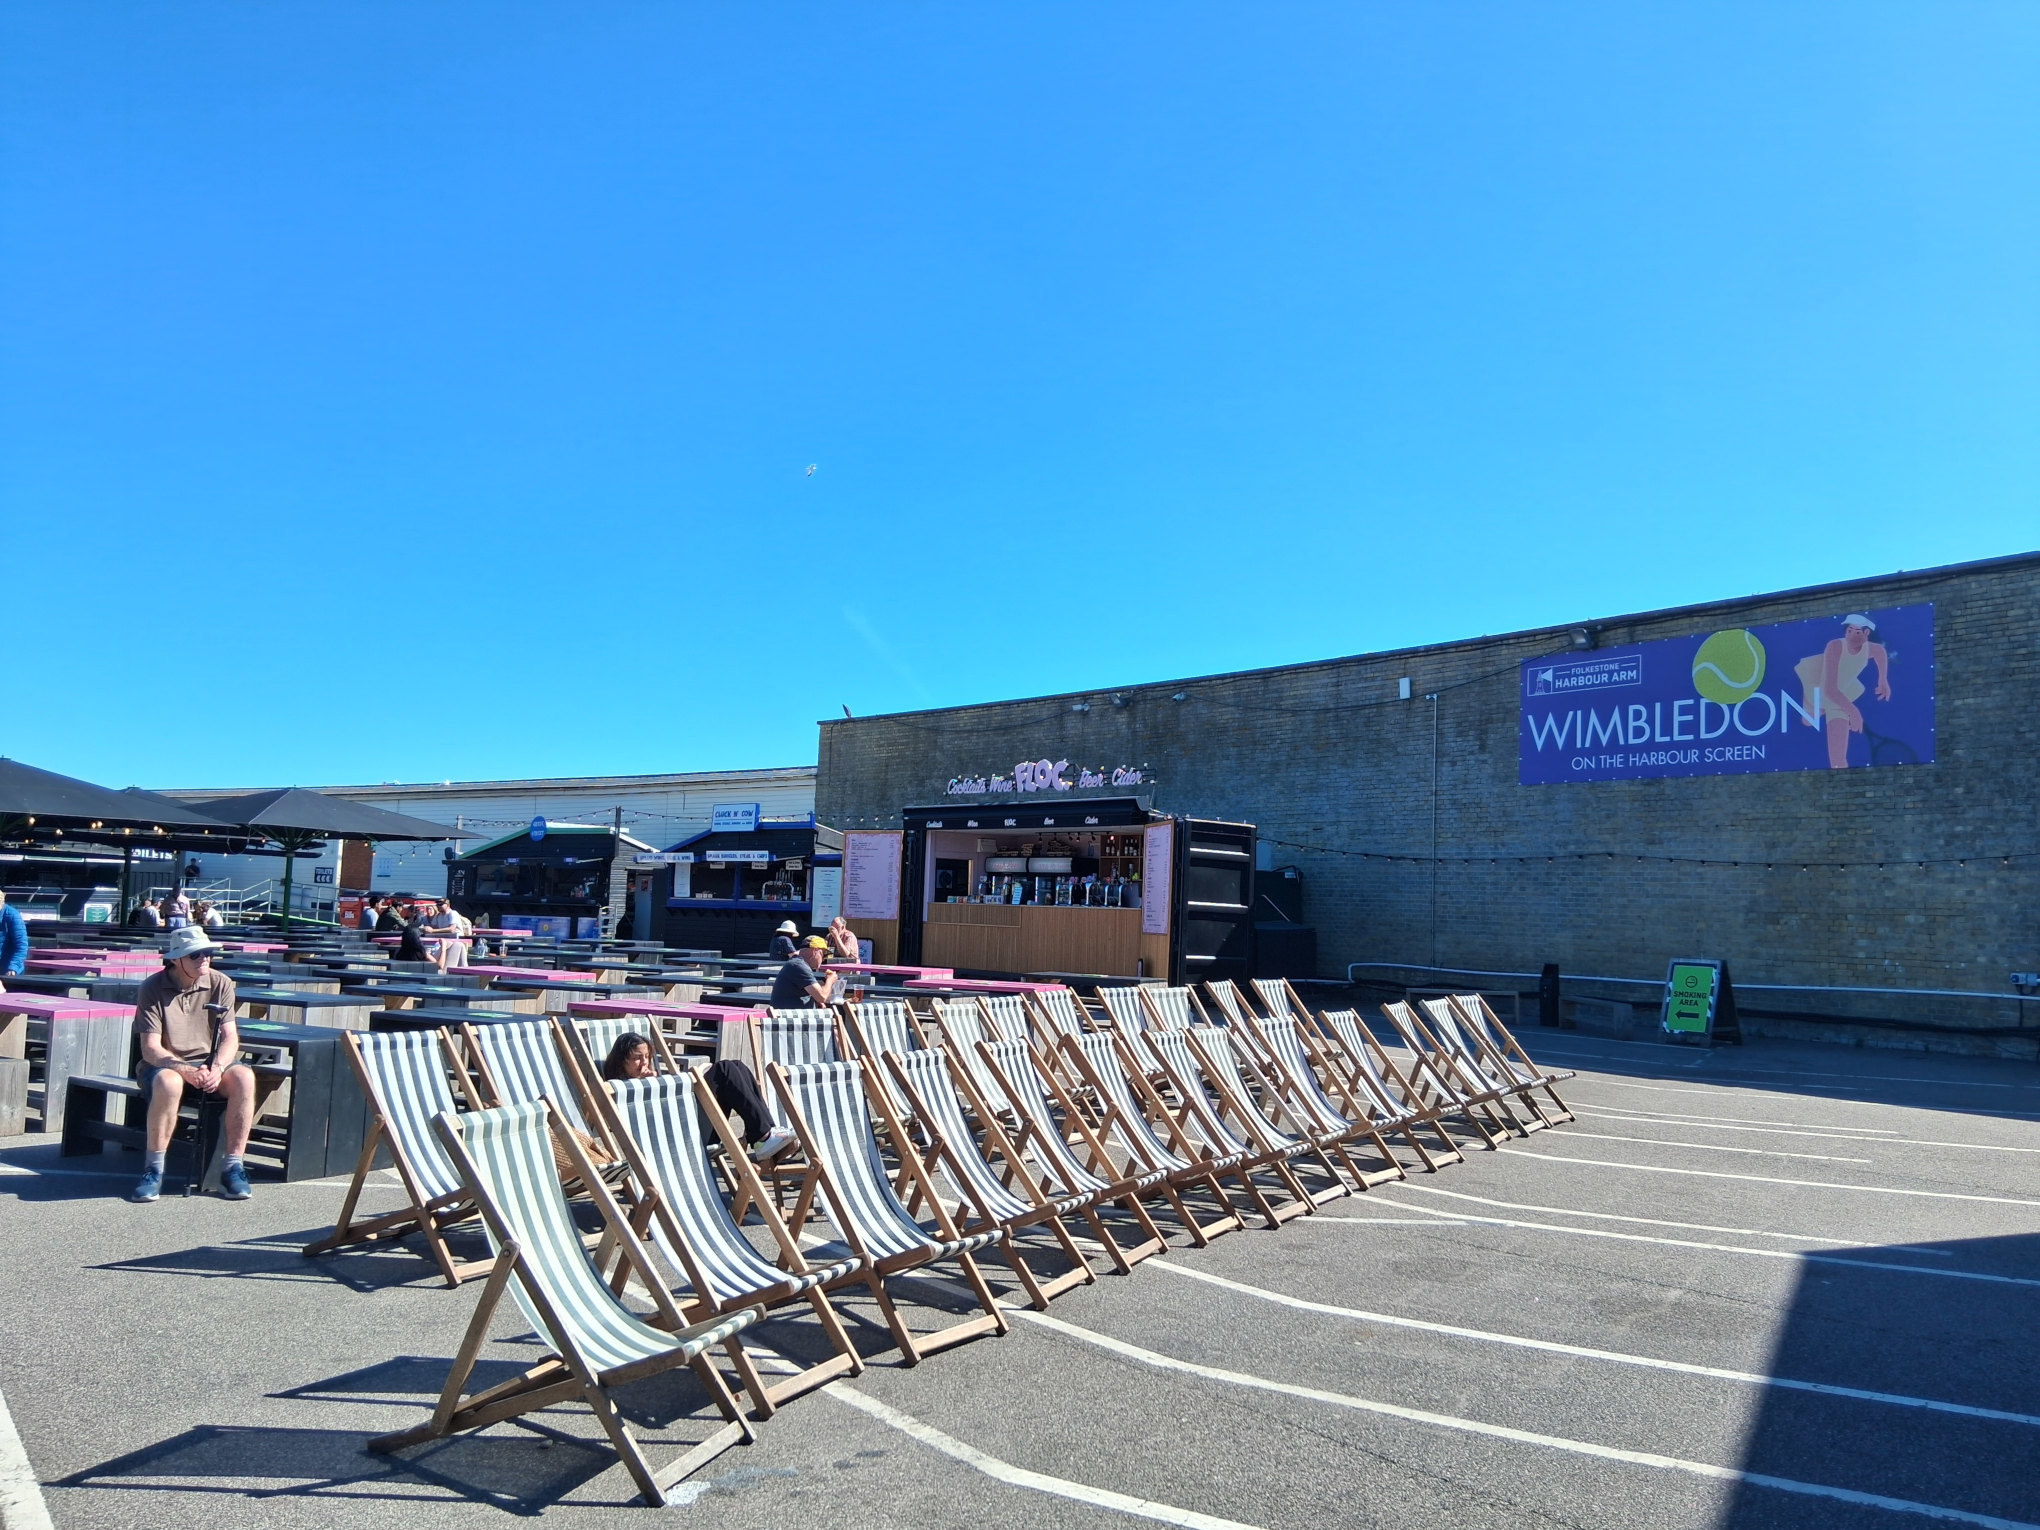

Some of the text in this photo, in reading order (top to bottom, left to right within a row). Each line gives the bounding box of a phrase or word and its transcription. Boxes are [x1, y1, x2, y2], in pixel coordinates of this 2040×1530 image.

[1555, 669, 1637, 688] HARBOUR ARM
[1571, 663, 1620, 675] FOLKESTONE
[1527, 687, 1821, 752] WIMBLEDON
[1571, 744, 1766, 770] ON THE HARBOUR SCREEN
[947, 777, 987, 794] Cocktails
[989, 777, 1013, 792] Wine
[1079, 771, 1104, 788] Beer
[1111, 767, 1142, 786] Cider
[715, 810, 732, 818] CLUCK
[1673, 991, 1707, 999] SMOKING
